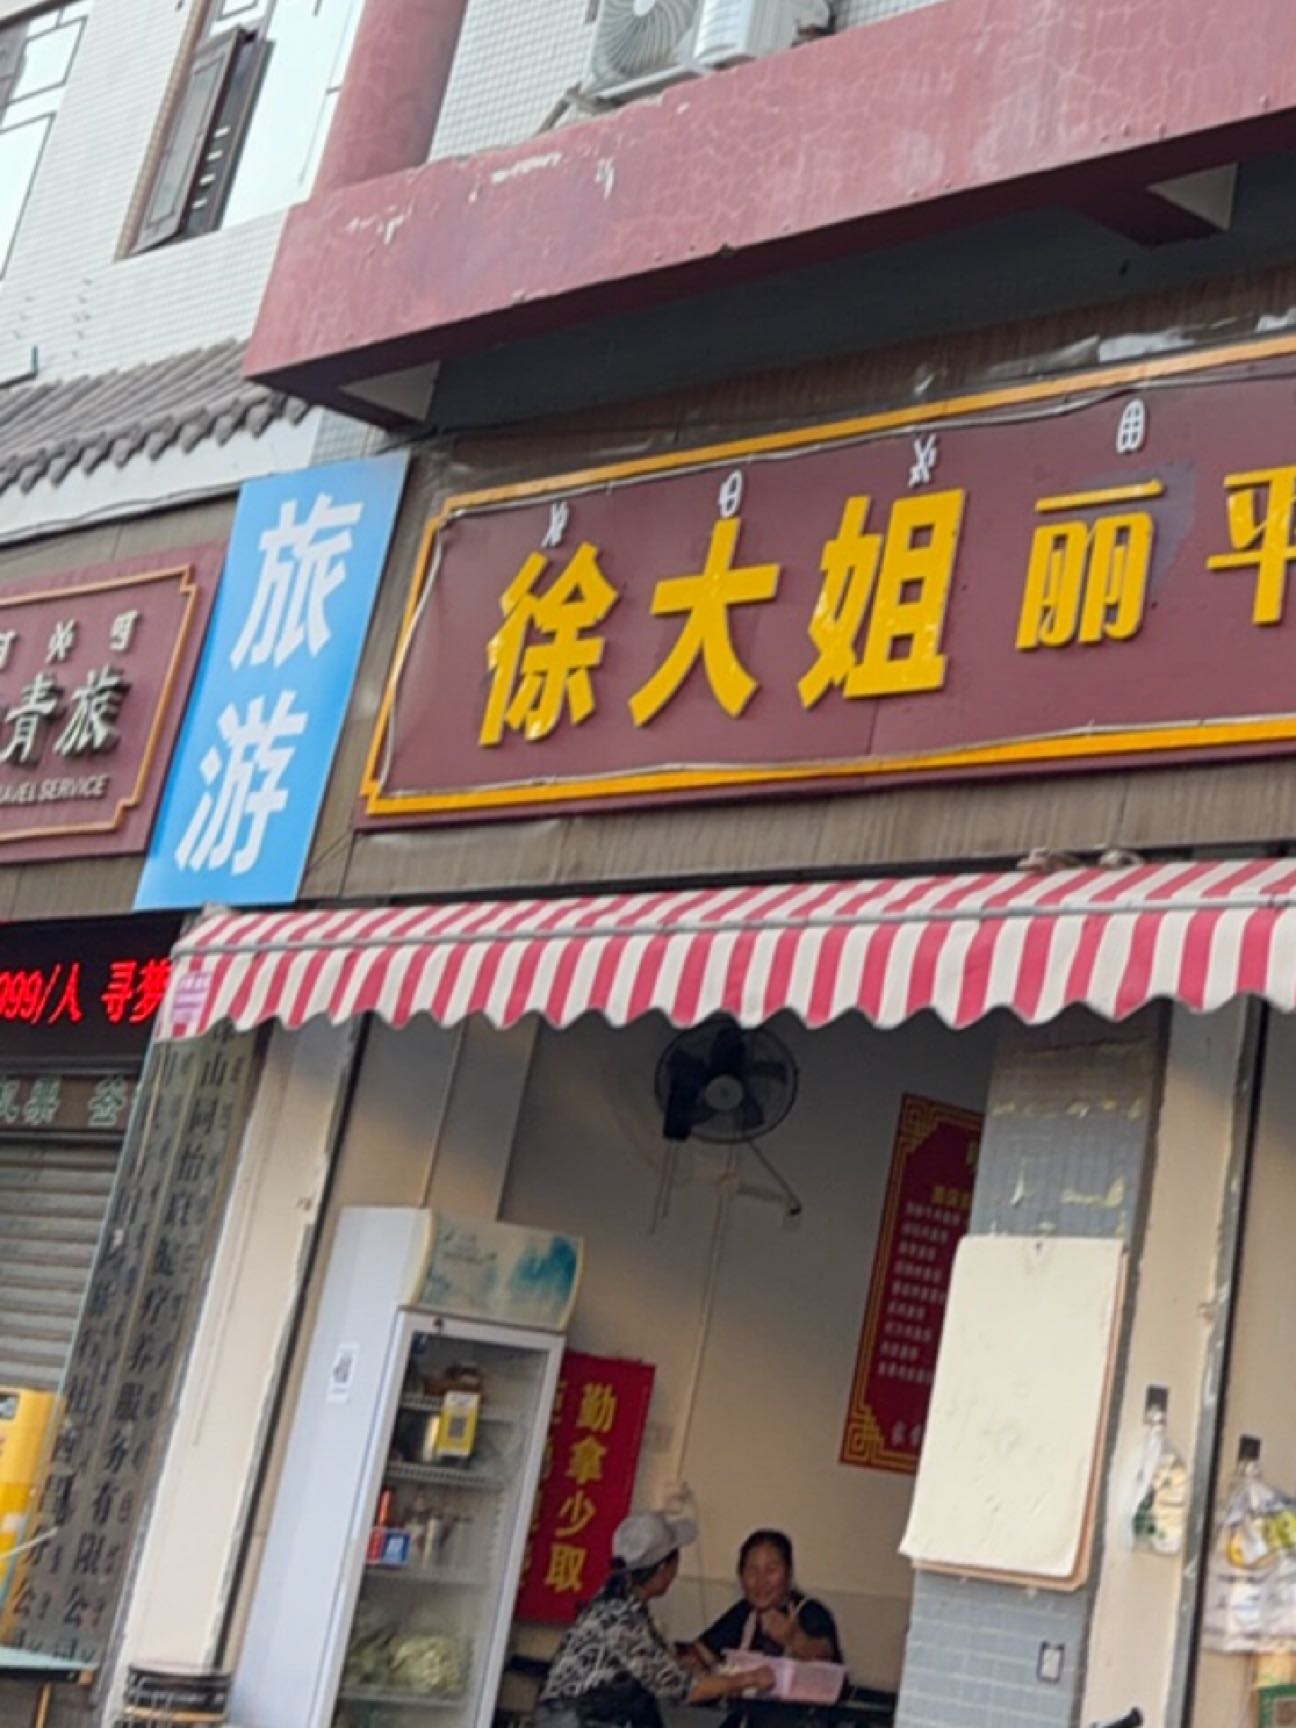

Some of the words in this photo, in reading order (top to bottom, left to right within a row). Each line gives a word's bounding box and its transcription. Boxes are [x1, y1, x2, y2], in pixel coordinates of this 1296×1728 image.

[173, 491, 364, 874] 旅游
[544, 1382, 618, 1593] 勤拿少取
